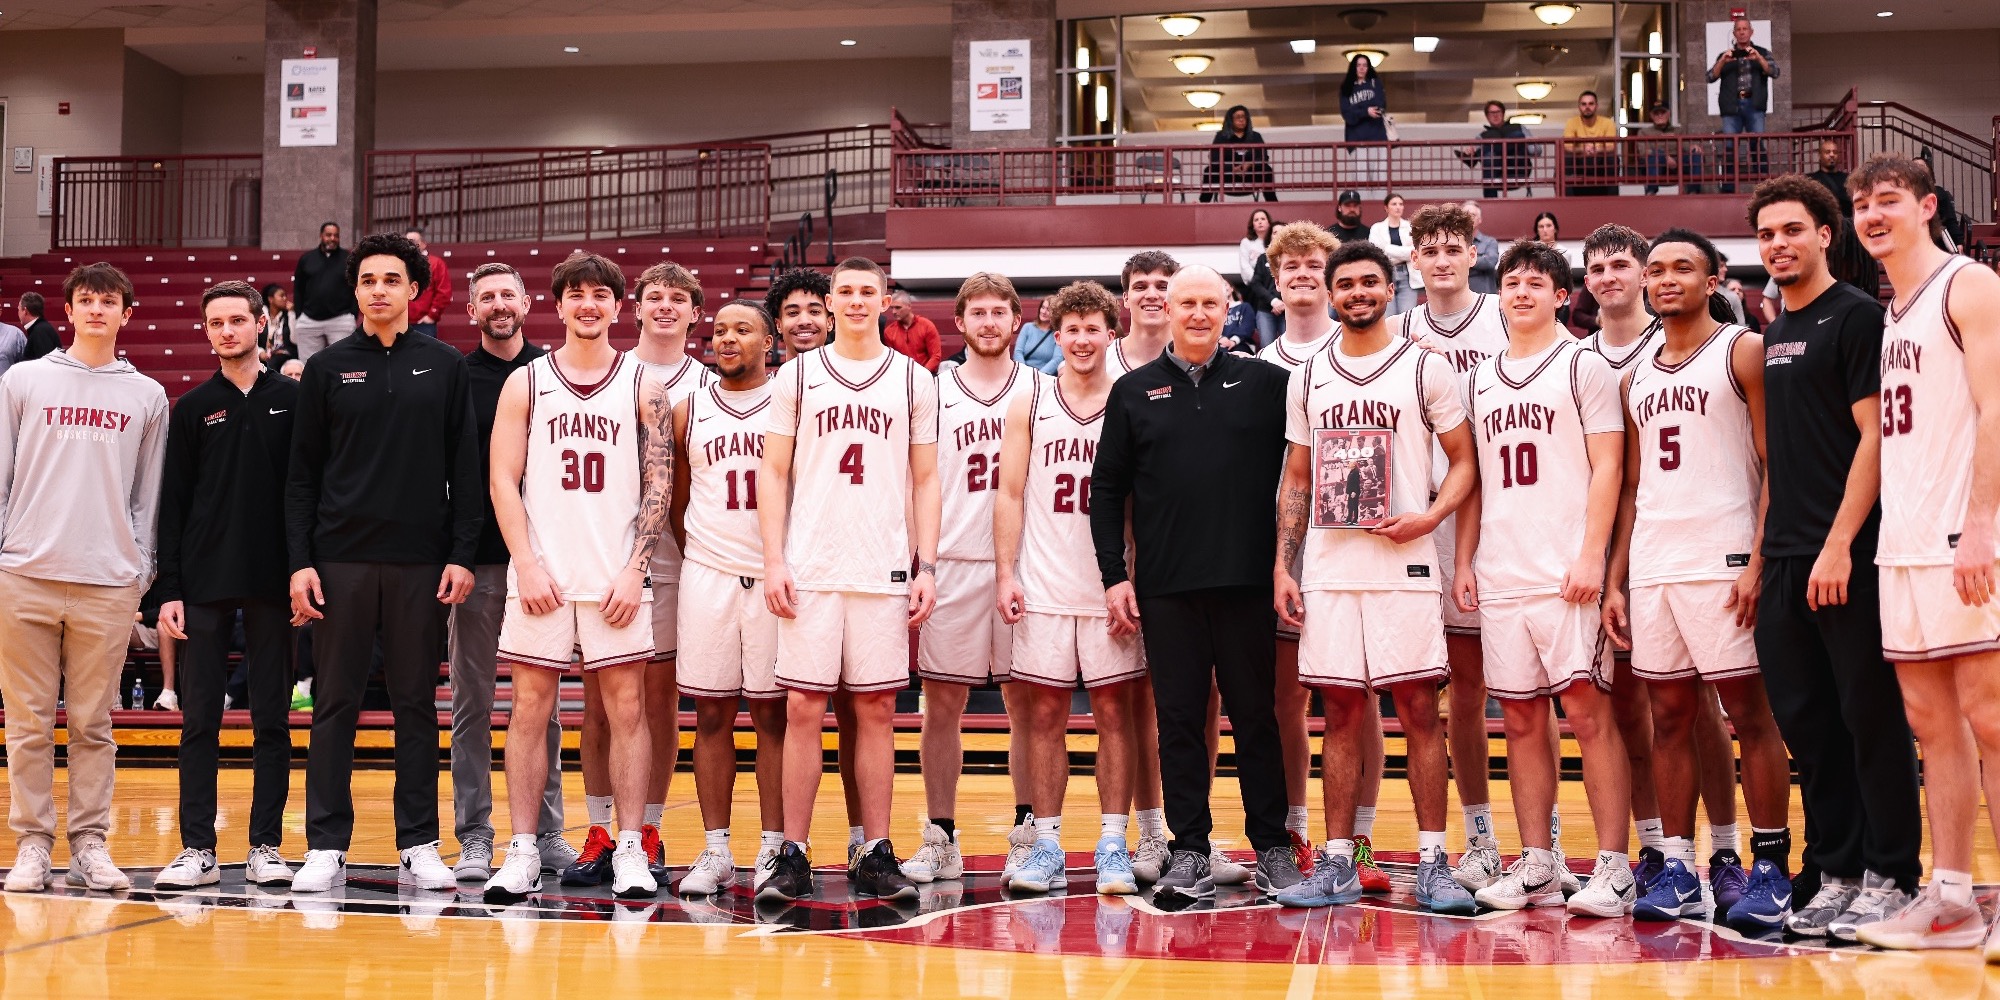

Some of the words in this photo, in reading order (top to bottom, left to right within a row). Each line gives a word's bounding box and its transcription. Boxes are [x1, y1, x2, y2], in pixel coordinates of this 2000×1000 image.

[1881, 339, 1922, 377] RANSY
[43, 406, 131, 432] TRANSY
[815, 404, 893, 440] TRANSY
[1320, 400, 1401, 433] TRANSY
[1483, 403, 1555, 443] TRANSY
[1637, 386, 1709, 428] TRANSY
[1883, 385, 1913, 437] 33
[57, 429, 116, 444] BASKETBALL
[547, 412, 621, 446] TRANSY
[953, 418, 1005, 451] TRAN
[1659, 426, 1681, 471] 5
[561, 448, 605, 494] 30
[838, 443, 864, 485] 4
[1044, 438, 1099, 467] TRAN
[1500, 443, 1538, 488] 10
[725, 469, 758, 510] 11
